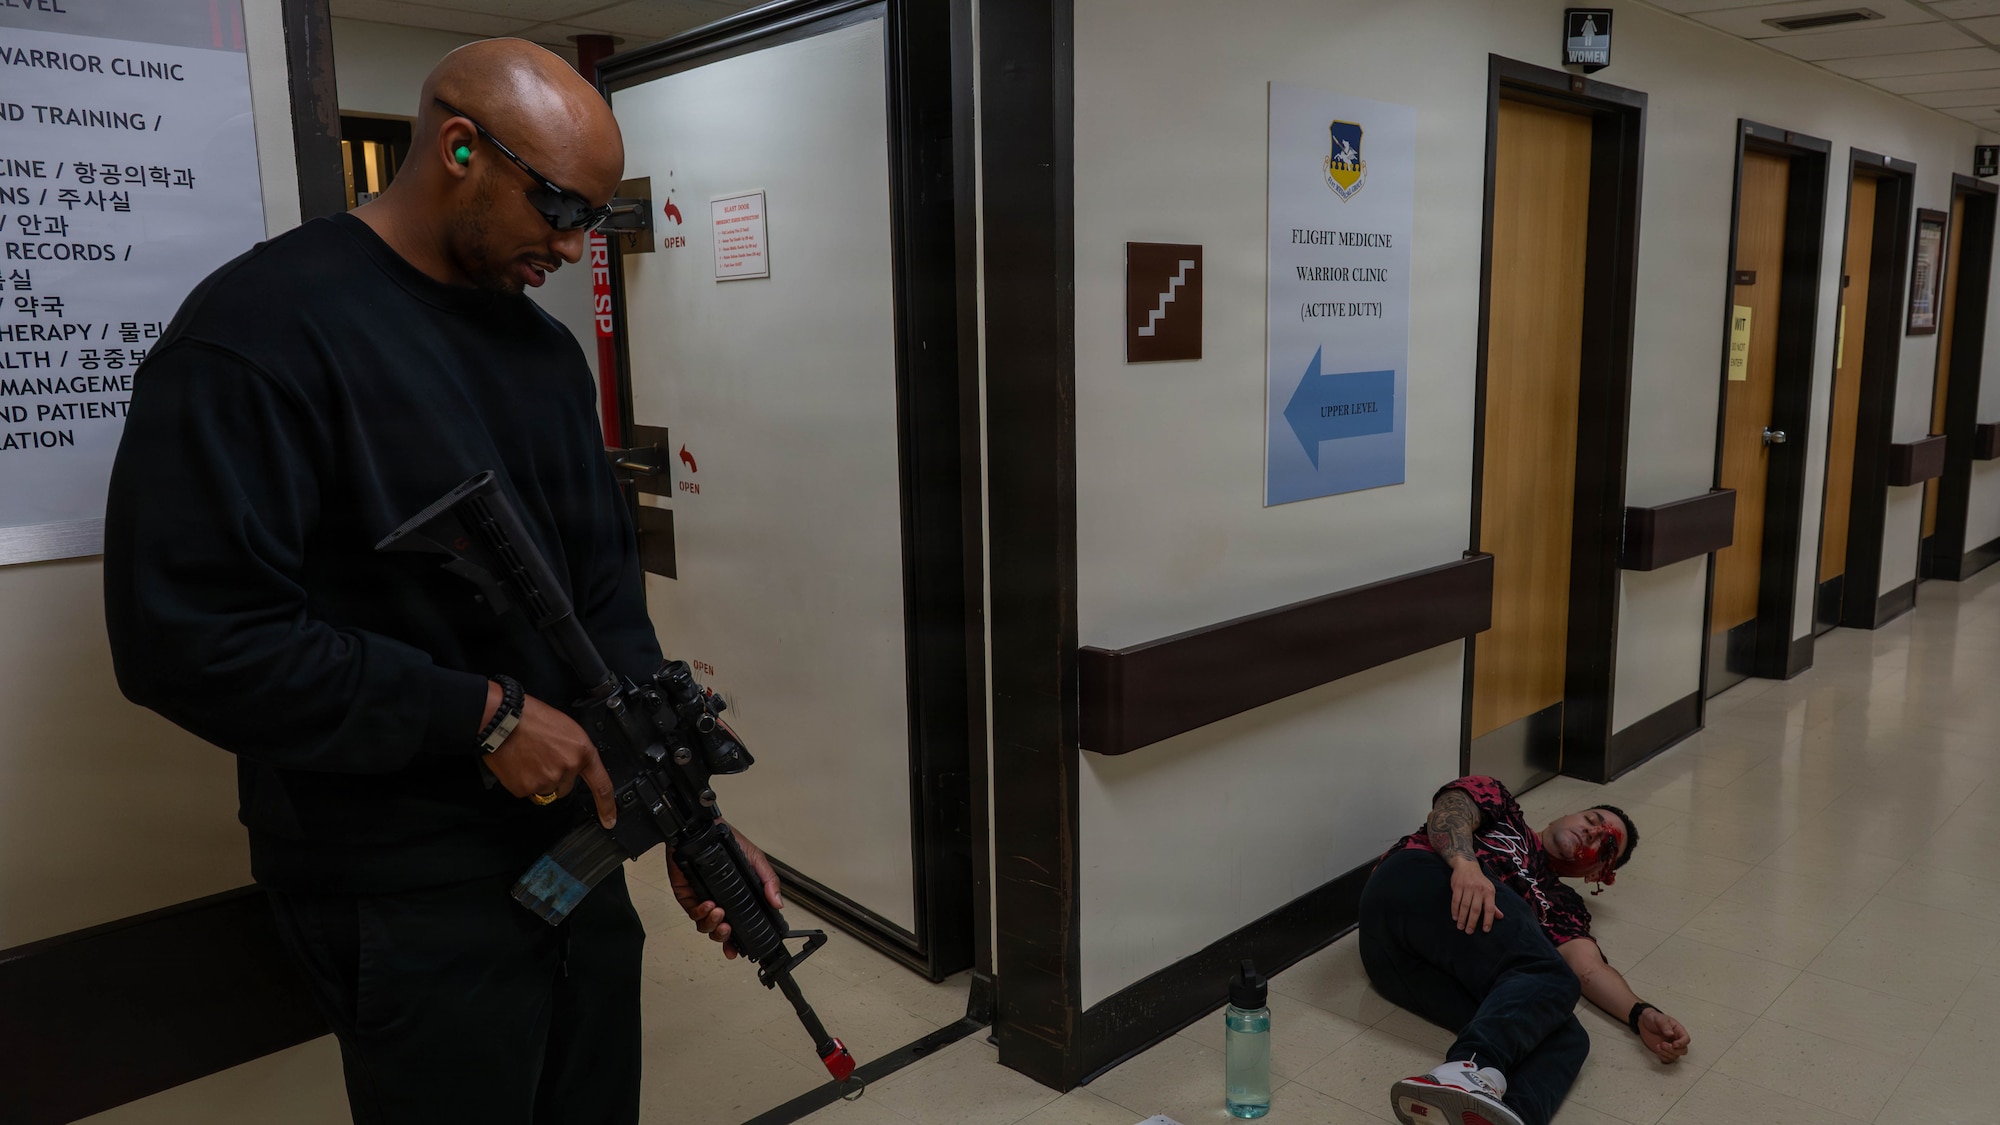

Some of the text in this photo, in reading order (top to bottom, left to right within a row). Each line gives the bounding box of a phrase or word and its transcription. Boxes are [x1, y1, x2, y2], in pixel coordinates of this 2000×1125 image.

[1568, 50, 1606, 63] WOMEN
[111, 58, 184, 81] CLINIC
[31, 105, 146, 131] TRAINING
[153, 115, 162, 132] /
[55, 162, 64, 179] /
[72, 161, 196, 189] 항공의학과
[0, 187, 131, 212] NS / 주사실
[16, 214, 69, 237] 안과
[664, 235, 686, 249] OPEN
[1291, 229, 1393, 248] FLIGHT MEDICINE
[5, 242, 132, 262] RECORDS /
[1296, 266, 1388, 282] WARRIOR CLINIC
[14, 296, 64, 318] 약국
[593, 294, 614, 334] SP
[1300, 302, 1383, 322] (ACTIVE DUTY)
[0, 323, 92, 342] HERAPY
[101, 323, 109, 340] /
[60, 350, 69, 368] /
[0, 375, 133, 396] MANAGEME
[37, 401, 131, 421] PATIENT
[1320, 401, 1378, 418] UPPER LEVEL
[0, 430, 75, 451] ATION
[679, 480, 700, 495] OPEN
[693, 659, 714, 676] OPEN
